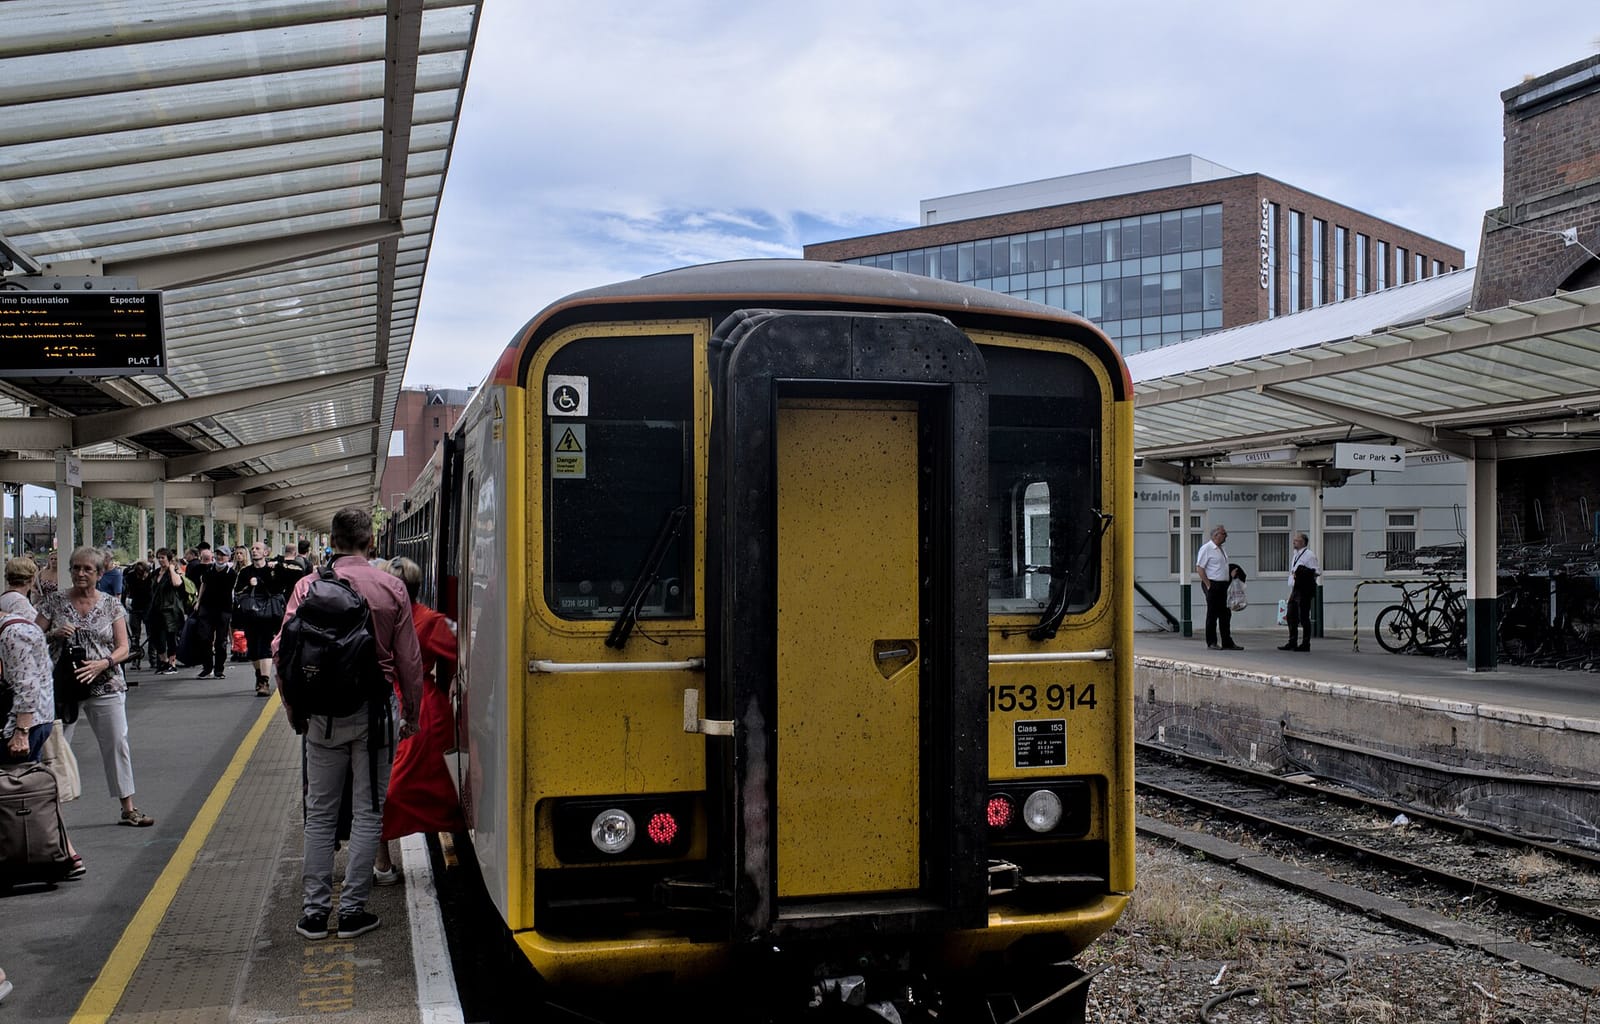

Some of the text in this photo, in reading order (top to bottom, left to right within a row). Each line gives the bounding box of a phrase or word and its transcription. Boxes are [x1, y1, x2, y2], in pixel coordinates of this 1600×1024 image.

[20, 296, 69, 304] Destination
[109, 296, 145, 305] Expected
[128, 354, 161, 367] PLAT 1
[1245, 452, 1271, 462] CHESTER
[1353, 453, 1386, 462] Car Park
[1421, 454, 1450, 464] CHESTER
[1140, 490, 1297, 502] trainin & simulator centre
[988, 684, 1098, 712] 153 914
[1017, 723, 1063, 733] Class 153
